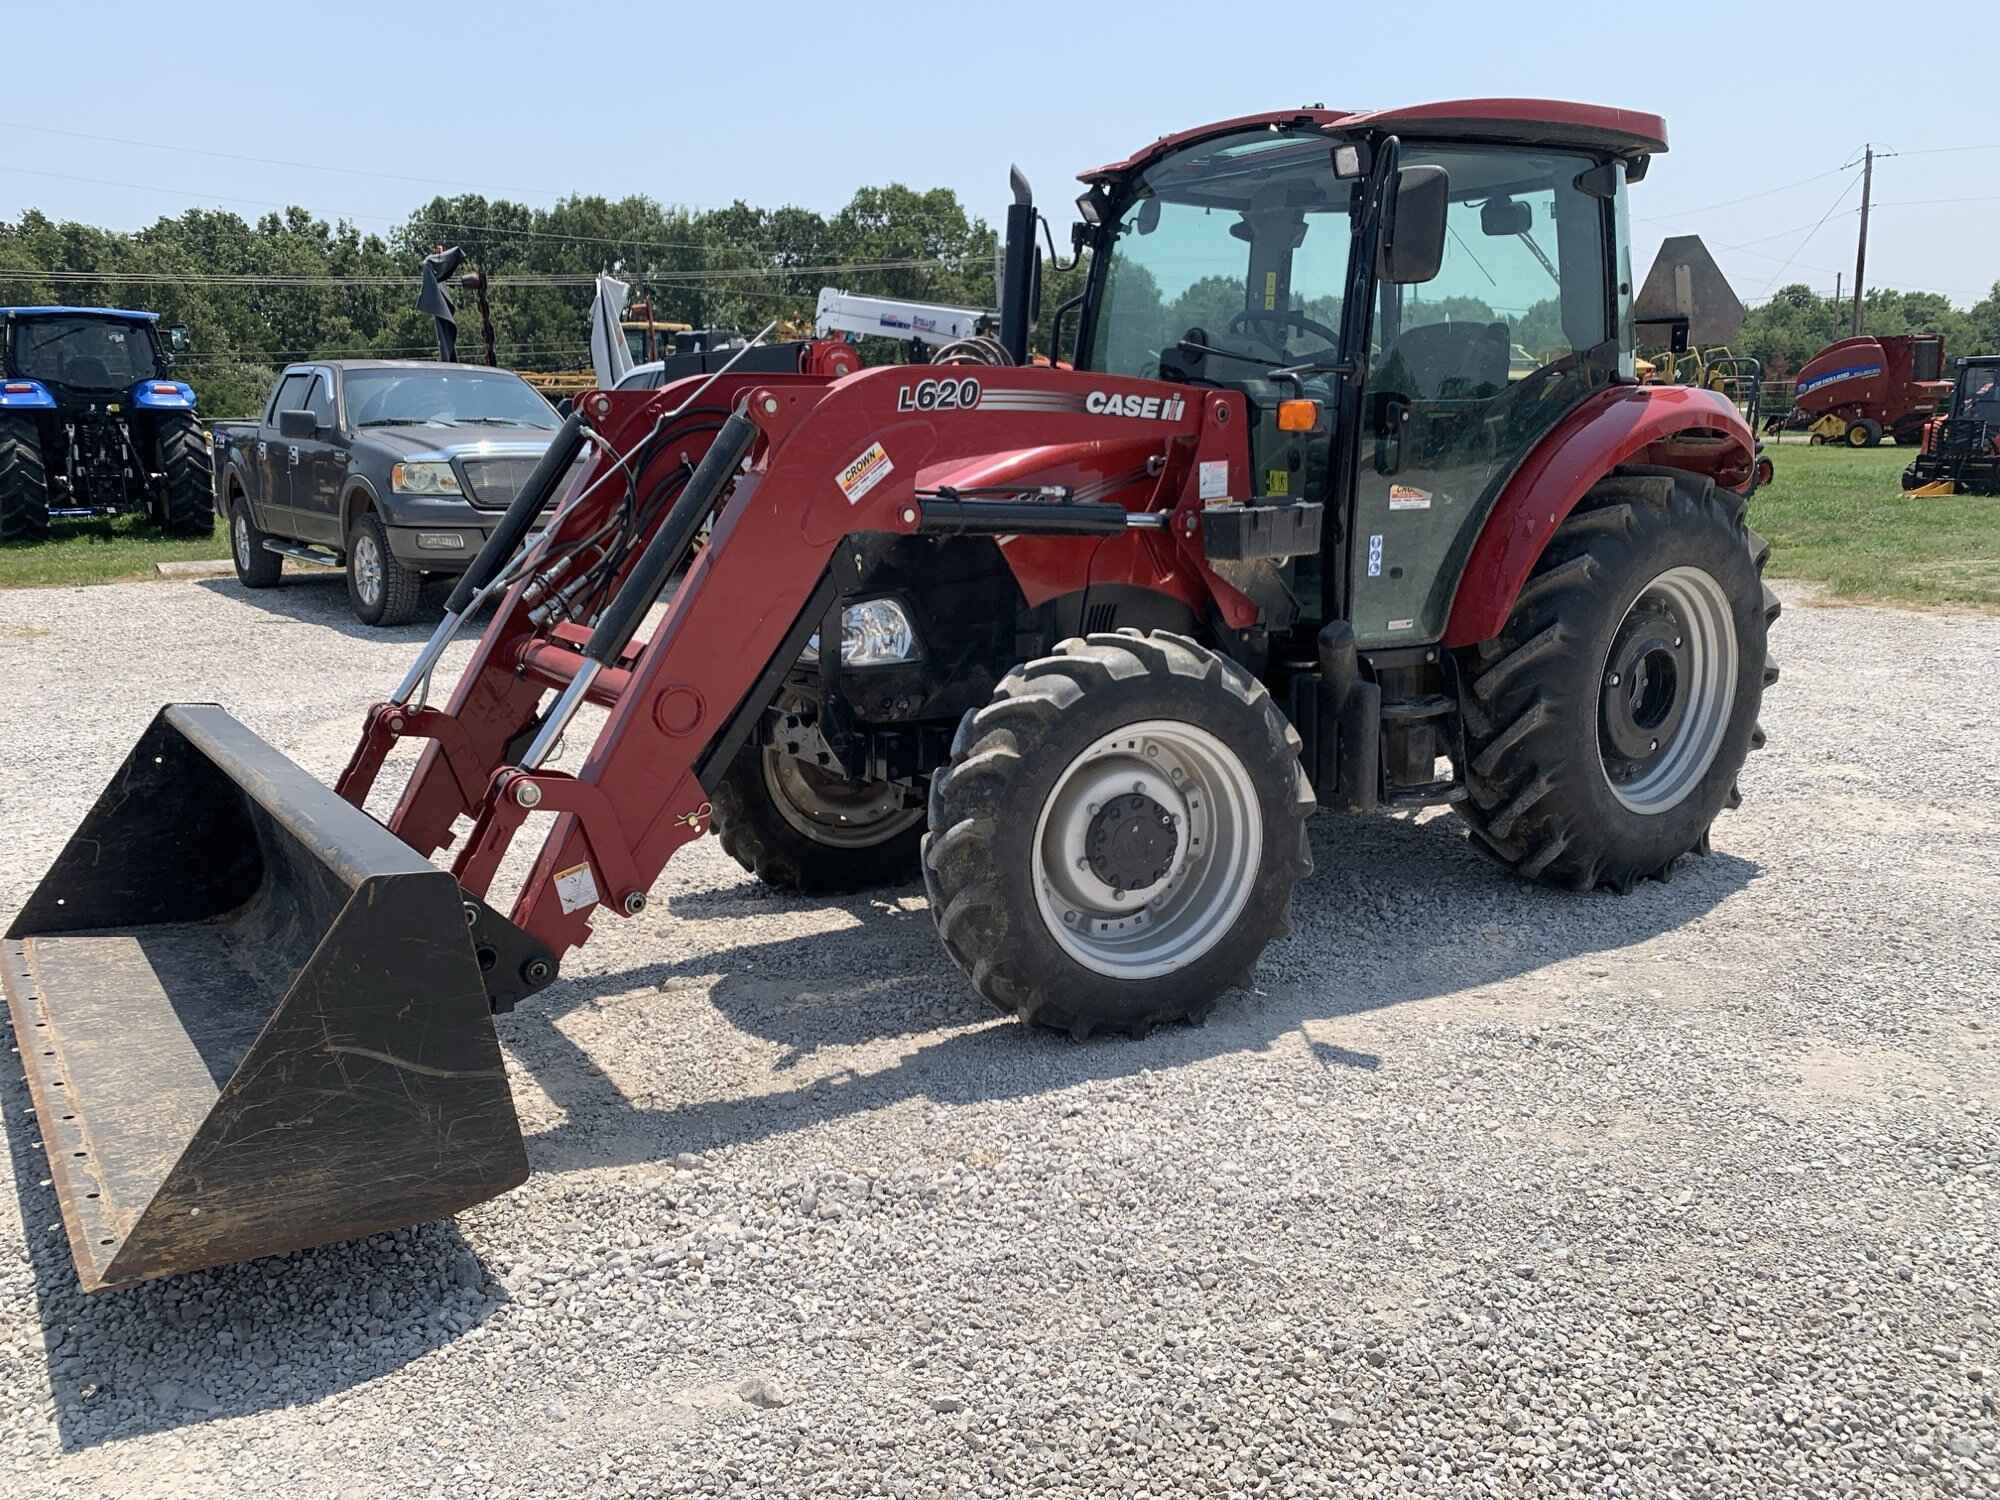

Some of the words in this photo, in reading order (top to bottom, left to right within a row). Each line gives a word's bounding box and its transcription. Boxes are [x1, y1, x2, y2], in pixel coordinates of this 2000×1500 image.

[898, 378, 980, 412] L620
[1086, 391, 1160, 419] CASE
[845, 448, 876, 482] CROWN
